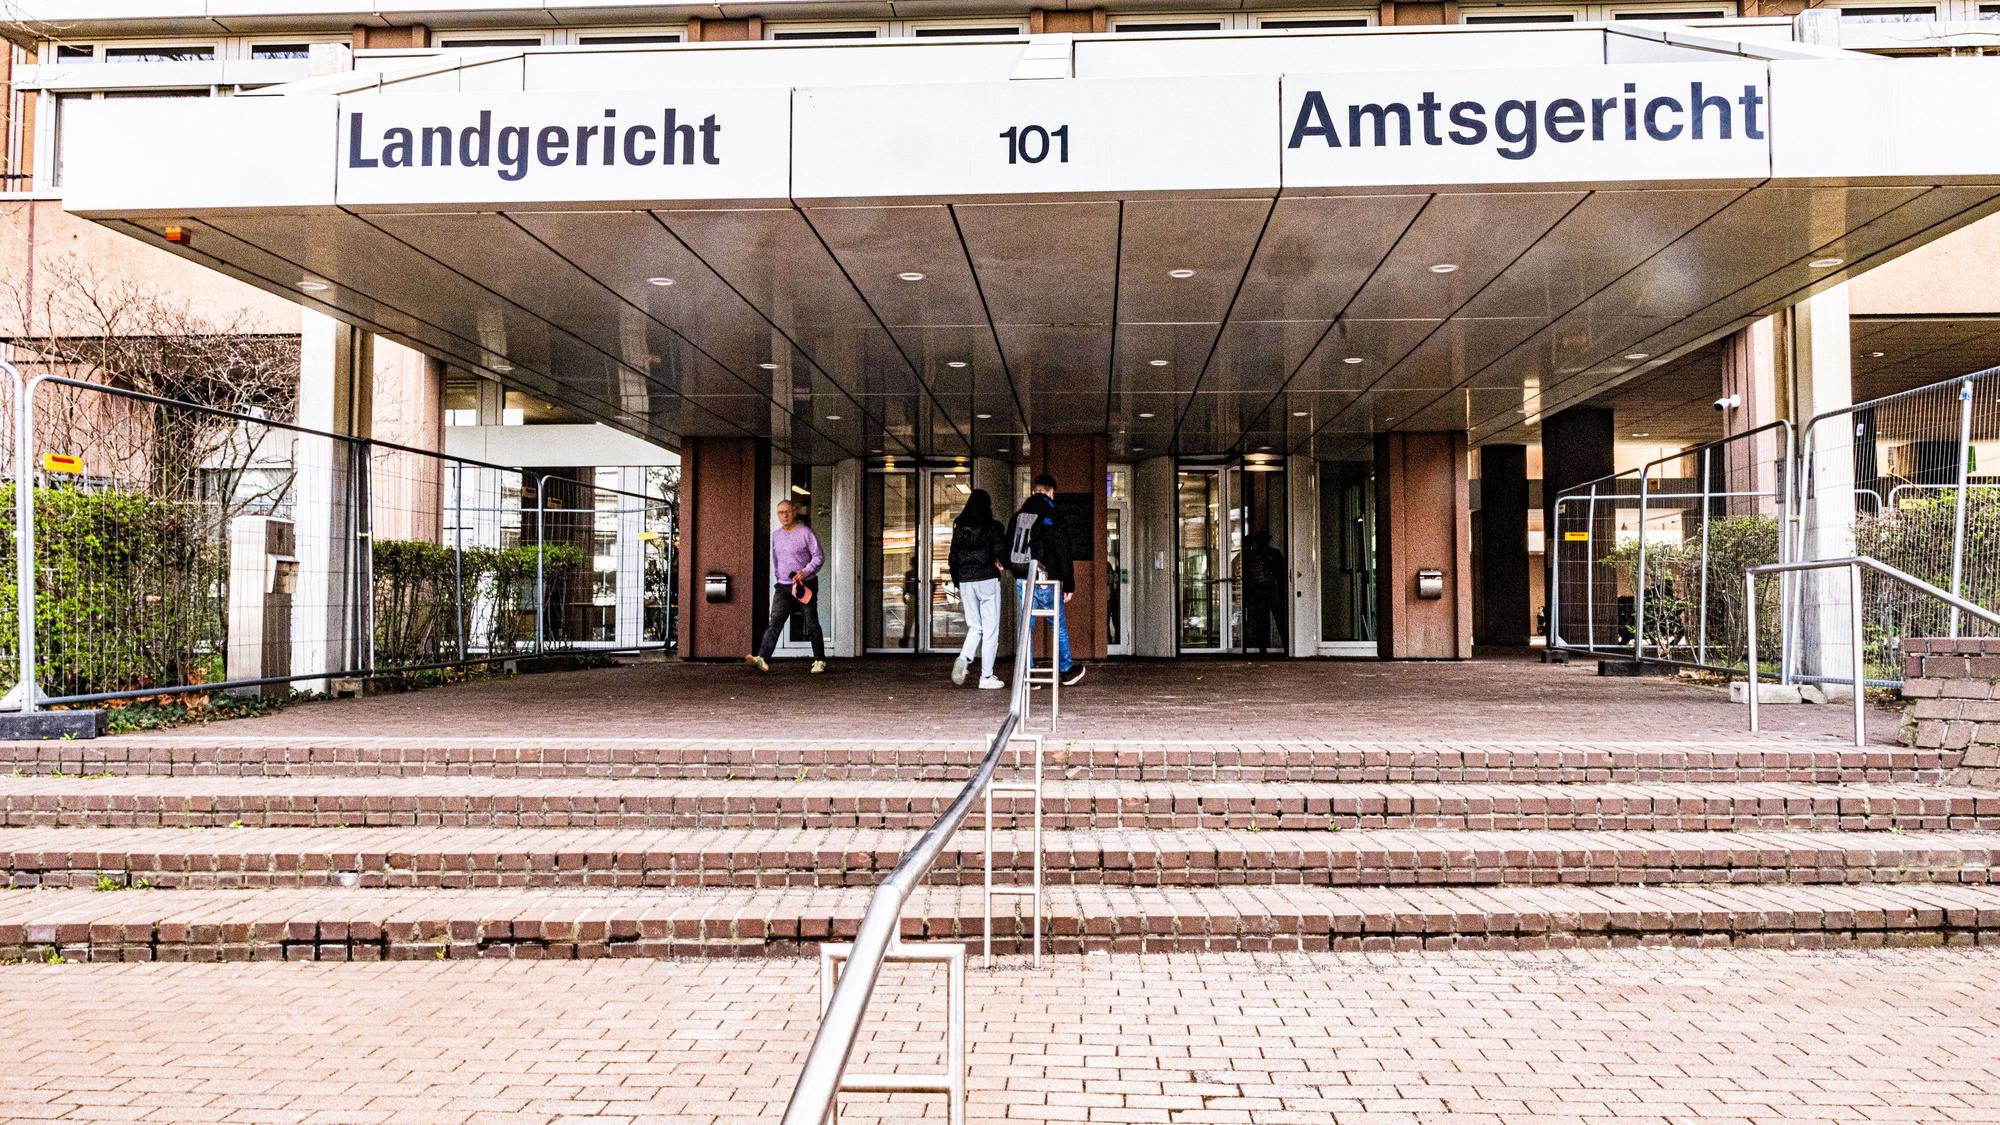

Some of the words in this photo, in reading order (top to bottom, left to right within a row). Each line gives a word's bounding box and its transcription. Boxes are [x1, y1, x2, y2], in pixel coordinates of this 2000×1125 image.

[349, 108, 721, 182] Landgericht
[999, 124, 1069, 164] 101
[1287, 82, 1764, 160] Amtsgericht
